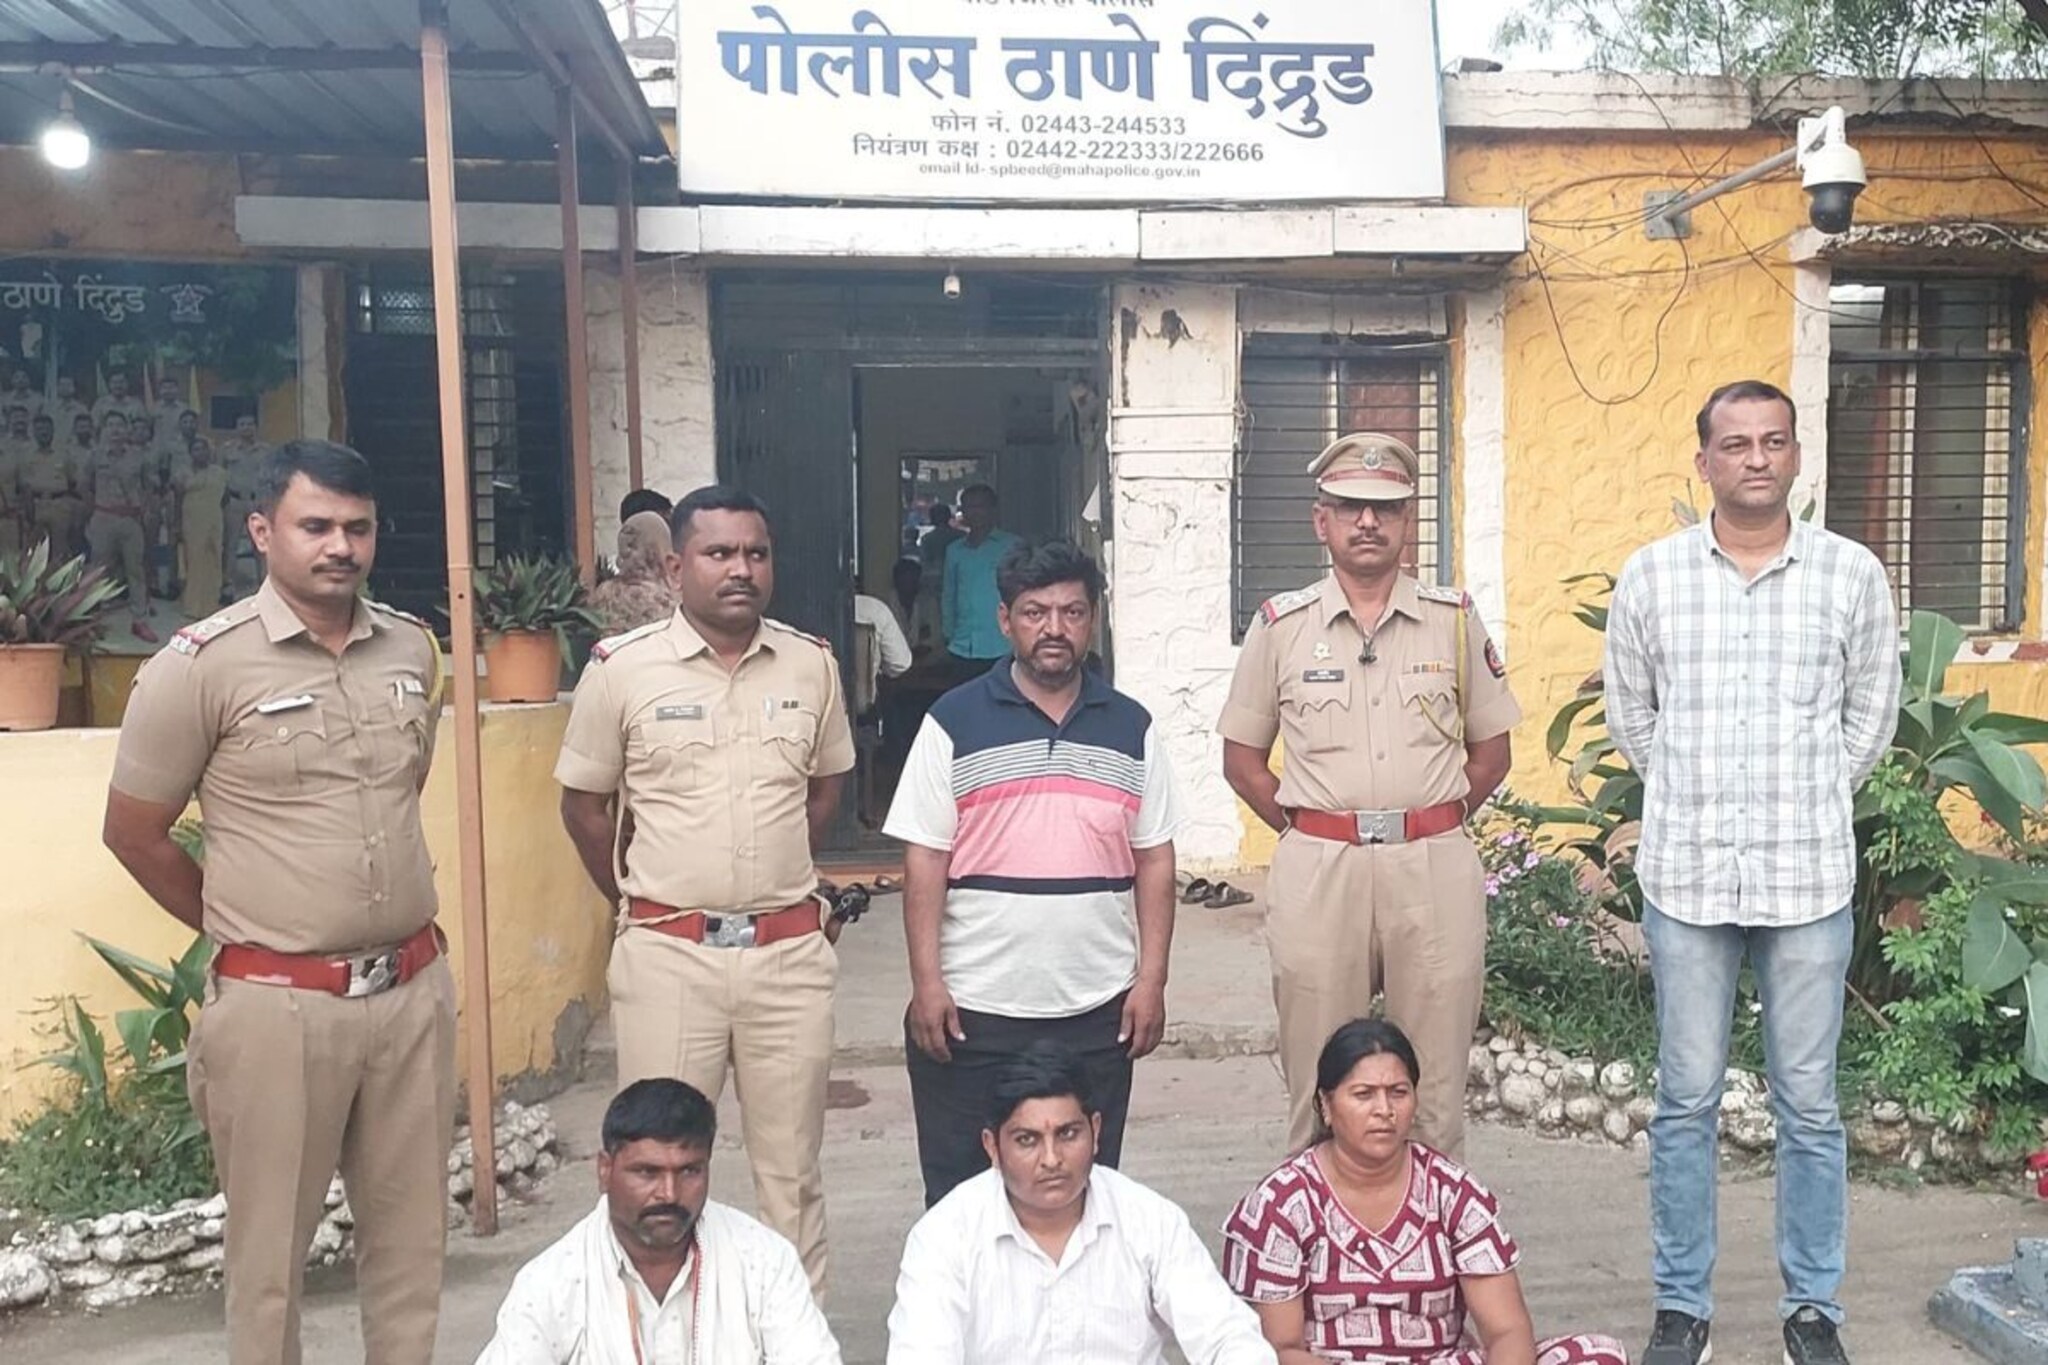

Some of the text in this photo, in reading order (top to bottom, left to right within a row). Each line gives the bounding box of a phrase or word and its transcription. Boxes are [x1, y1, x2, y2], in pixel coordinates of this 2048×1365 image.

[717, 5, 1374, 138] पोलीस ठाणे दिंद्रुड
[931, 109, 1186, 135] फोन नं. 02443-244533
[853, 132, 928, 156] नियंत्रण
[937, 139, 979, 157] कक्ष
[1006, 140, 1264, 161] 02442-222333/222666
[919, 163, 960, 174] email
[989, 164, 1201, 179] spbeed@mahapolice.gov.in
[0, 271, 62, 309] ठाणे
